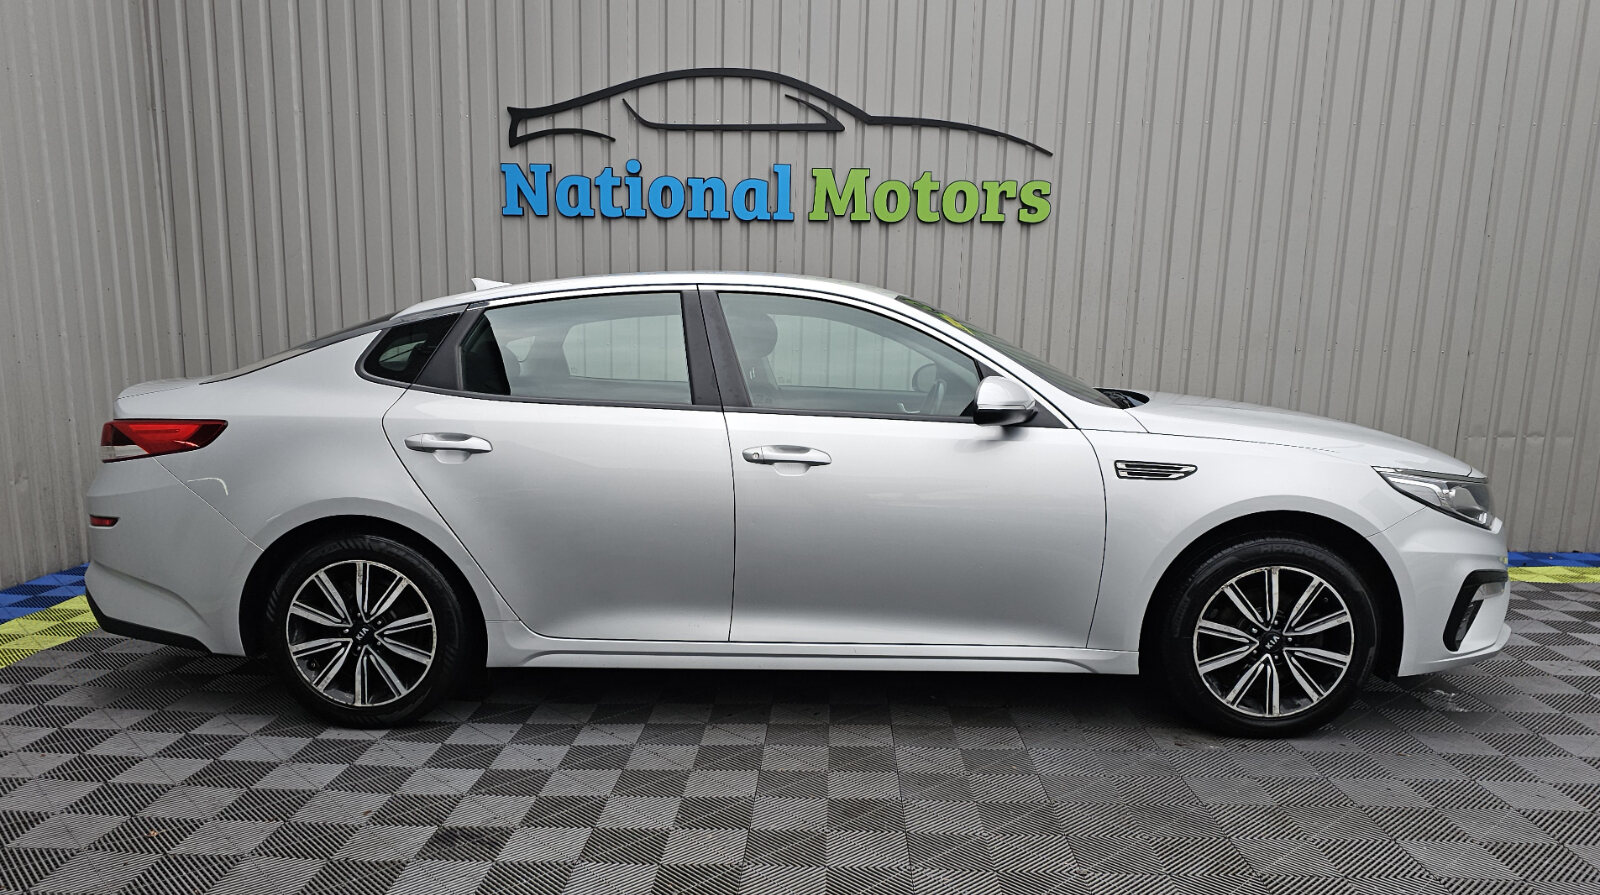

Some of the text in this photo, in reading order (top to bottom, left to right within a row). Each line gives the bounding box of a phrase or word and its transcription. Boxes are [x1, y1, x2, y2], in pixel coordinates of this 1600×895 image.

[500, 159, 1053, 224] National Motors
[355, 627, 370, 641] KIA
[1265, 635, 1280, 650] KIA
